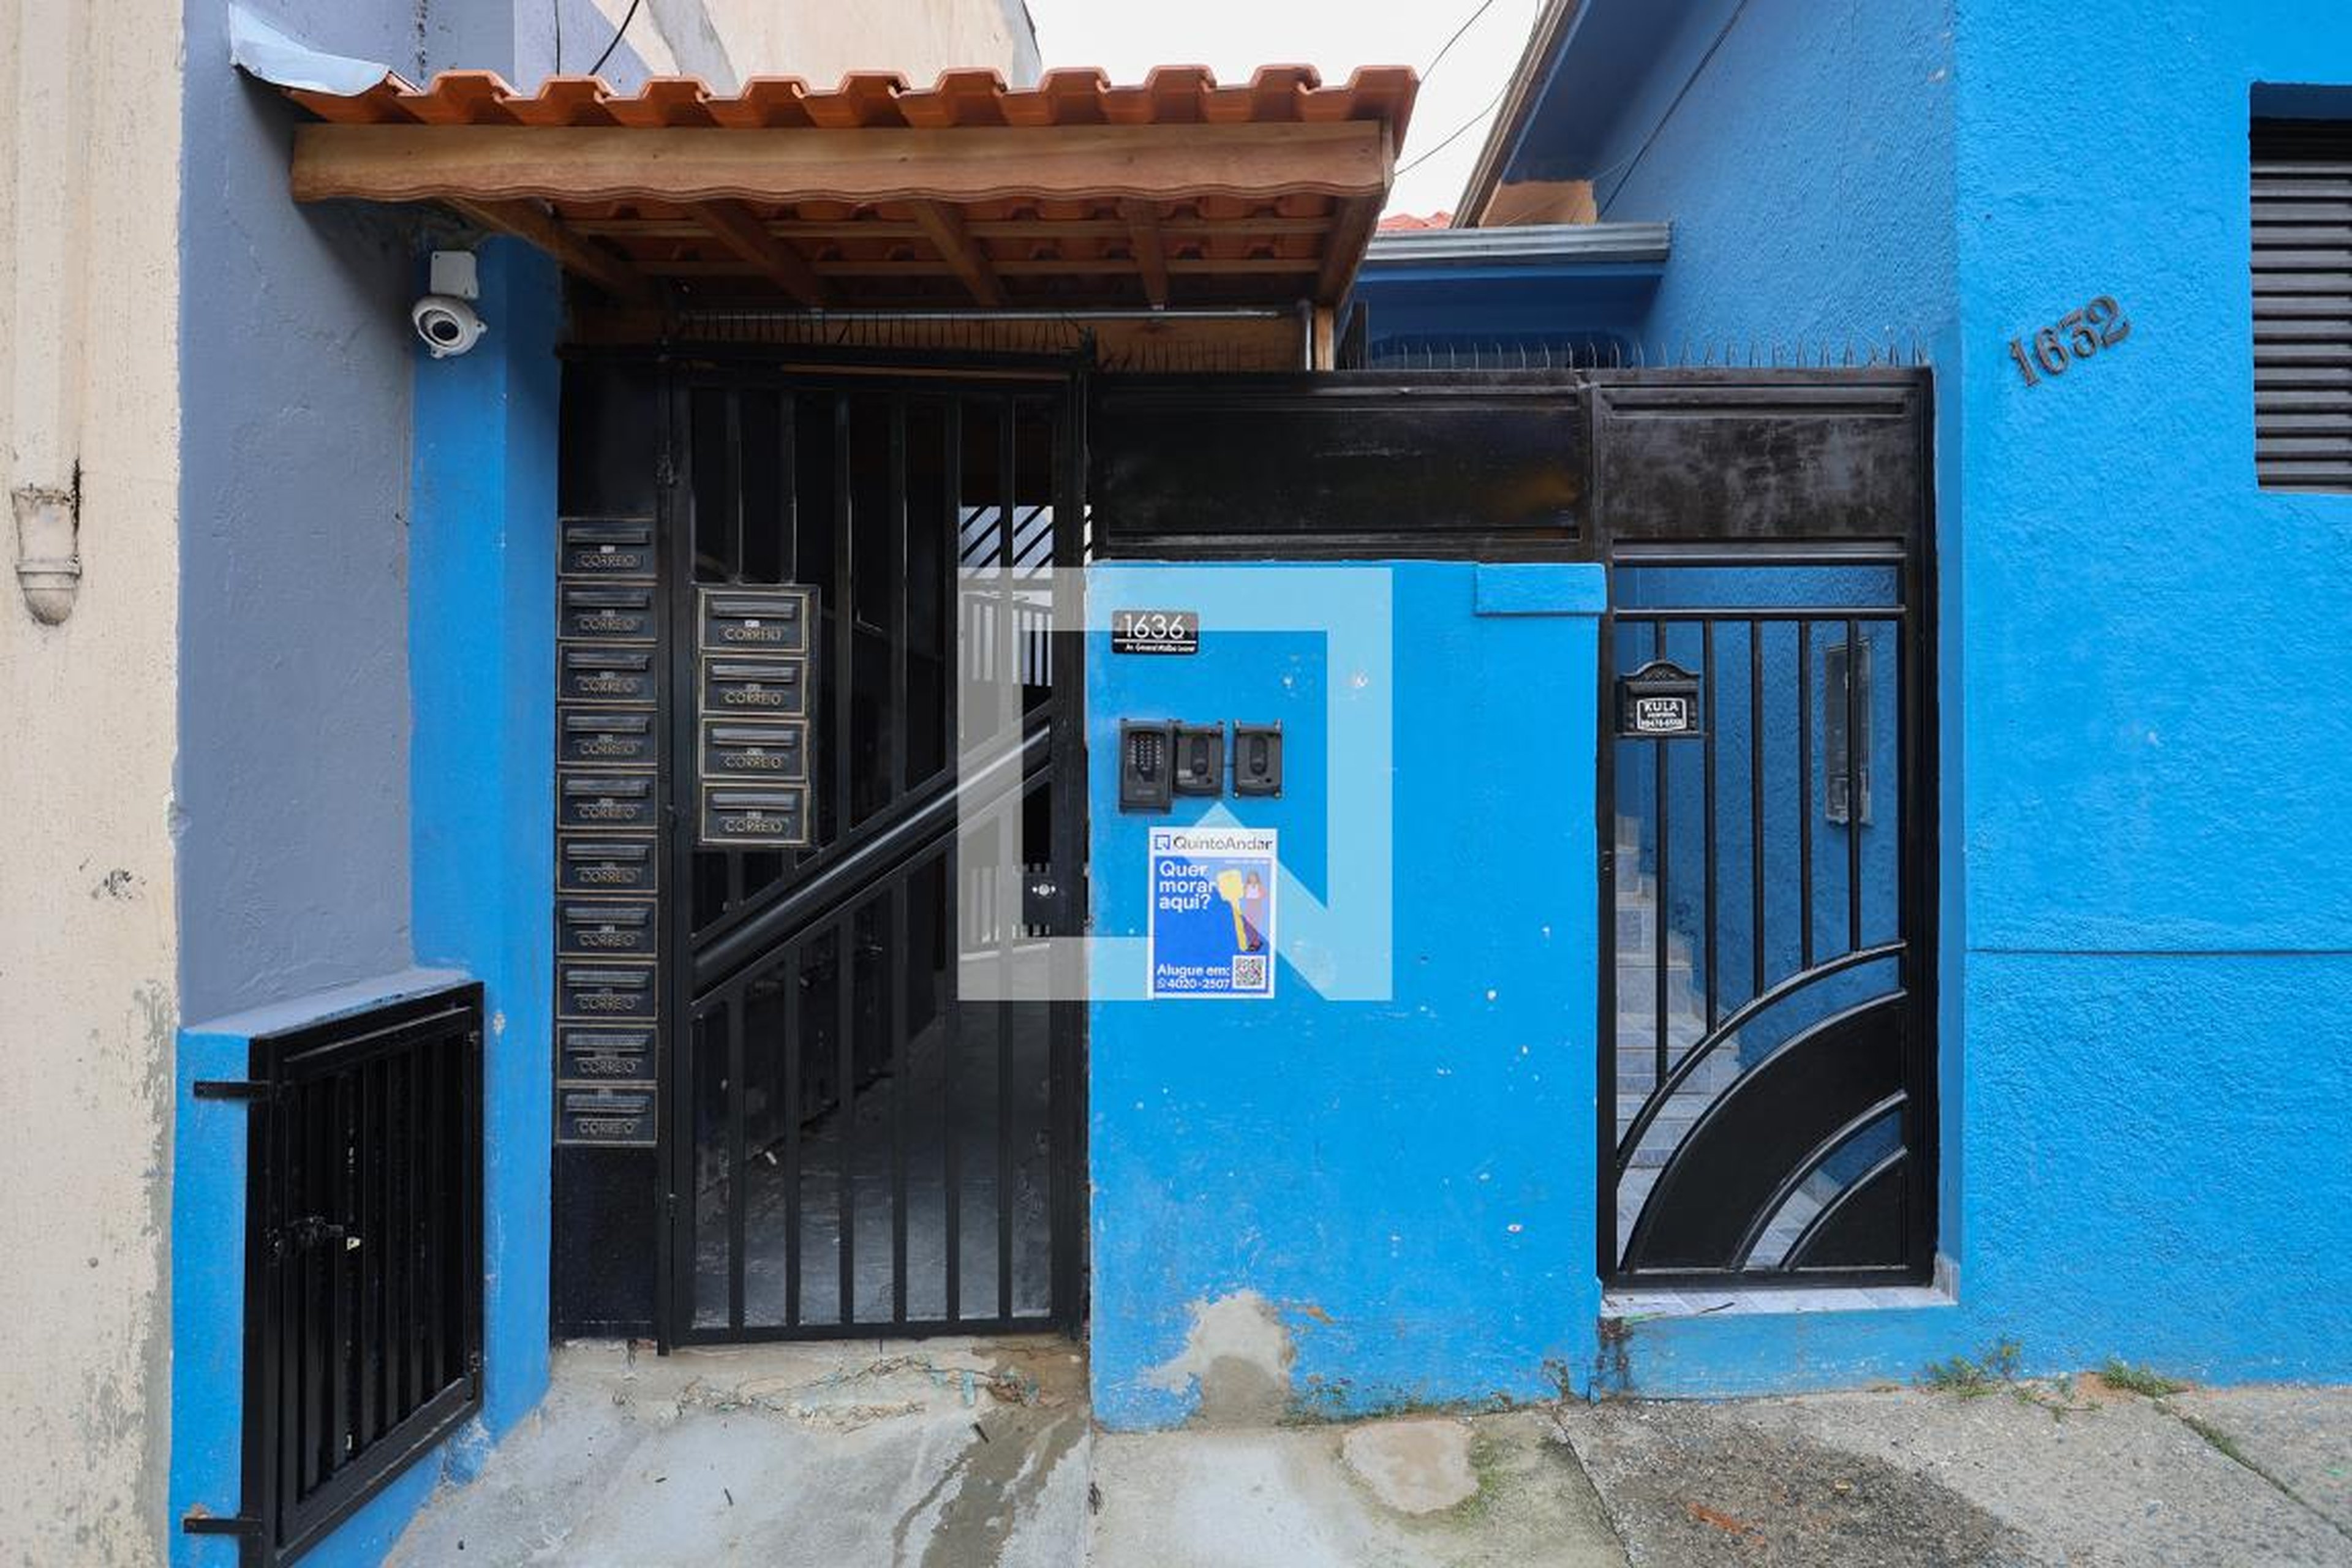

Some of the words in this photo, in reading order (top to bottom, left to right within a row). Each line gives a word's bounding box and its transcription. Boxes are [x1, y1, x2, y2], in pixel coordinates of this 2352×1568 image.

[2009, 295, 2129, 386] 1632
[581, 554, 637, 568] CORREIO
[579, 618, 636, 631] CORREIO
[1124, 613, 1185, 639] 1636
[724, 628, 782, 641] CORREIO
[579, 678, 636, 692] CORREIO
[725, 692, 782, 706] CORREIO
[1645, 701, 1679, 712] KULA
[579, 741, 636, 754] CORREIO
[725, 756, 783, 769] CORREIO
[579, 806, 636, 820] CORREIO
[725, 820, 783, 834] CORREIO
[1173, 835, 1273, 851] QuintoAndar
[1159, 860, 1208, 877] Quer
[579, 870, 636, 883] CORREIO
[1159, 880, 1216, 893] morar
[1159, 894, 1212, 913] aqui?
[579, 933, 636, 947] CORREIO
[1157, 963, 1204, 979] Alugue
[1206, 966, 1231, 976] em:
[579, 997, 636, 1010] CORREIO
[579, 1060, 636, 1074] CORREIO
[579, 1121, 636, 1135] CORREIO
